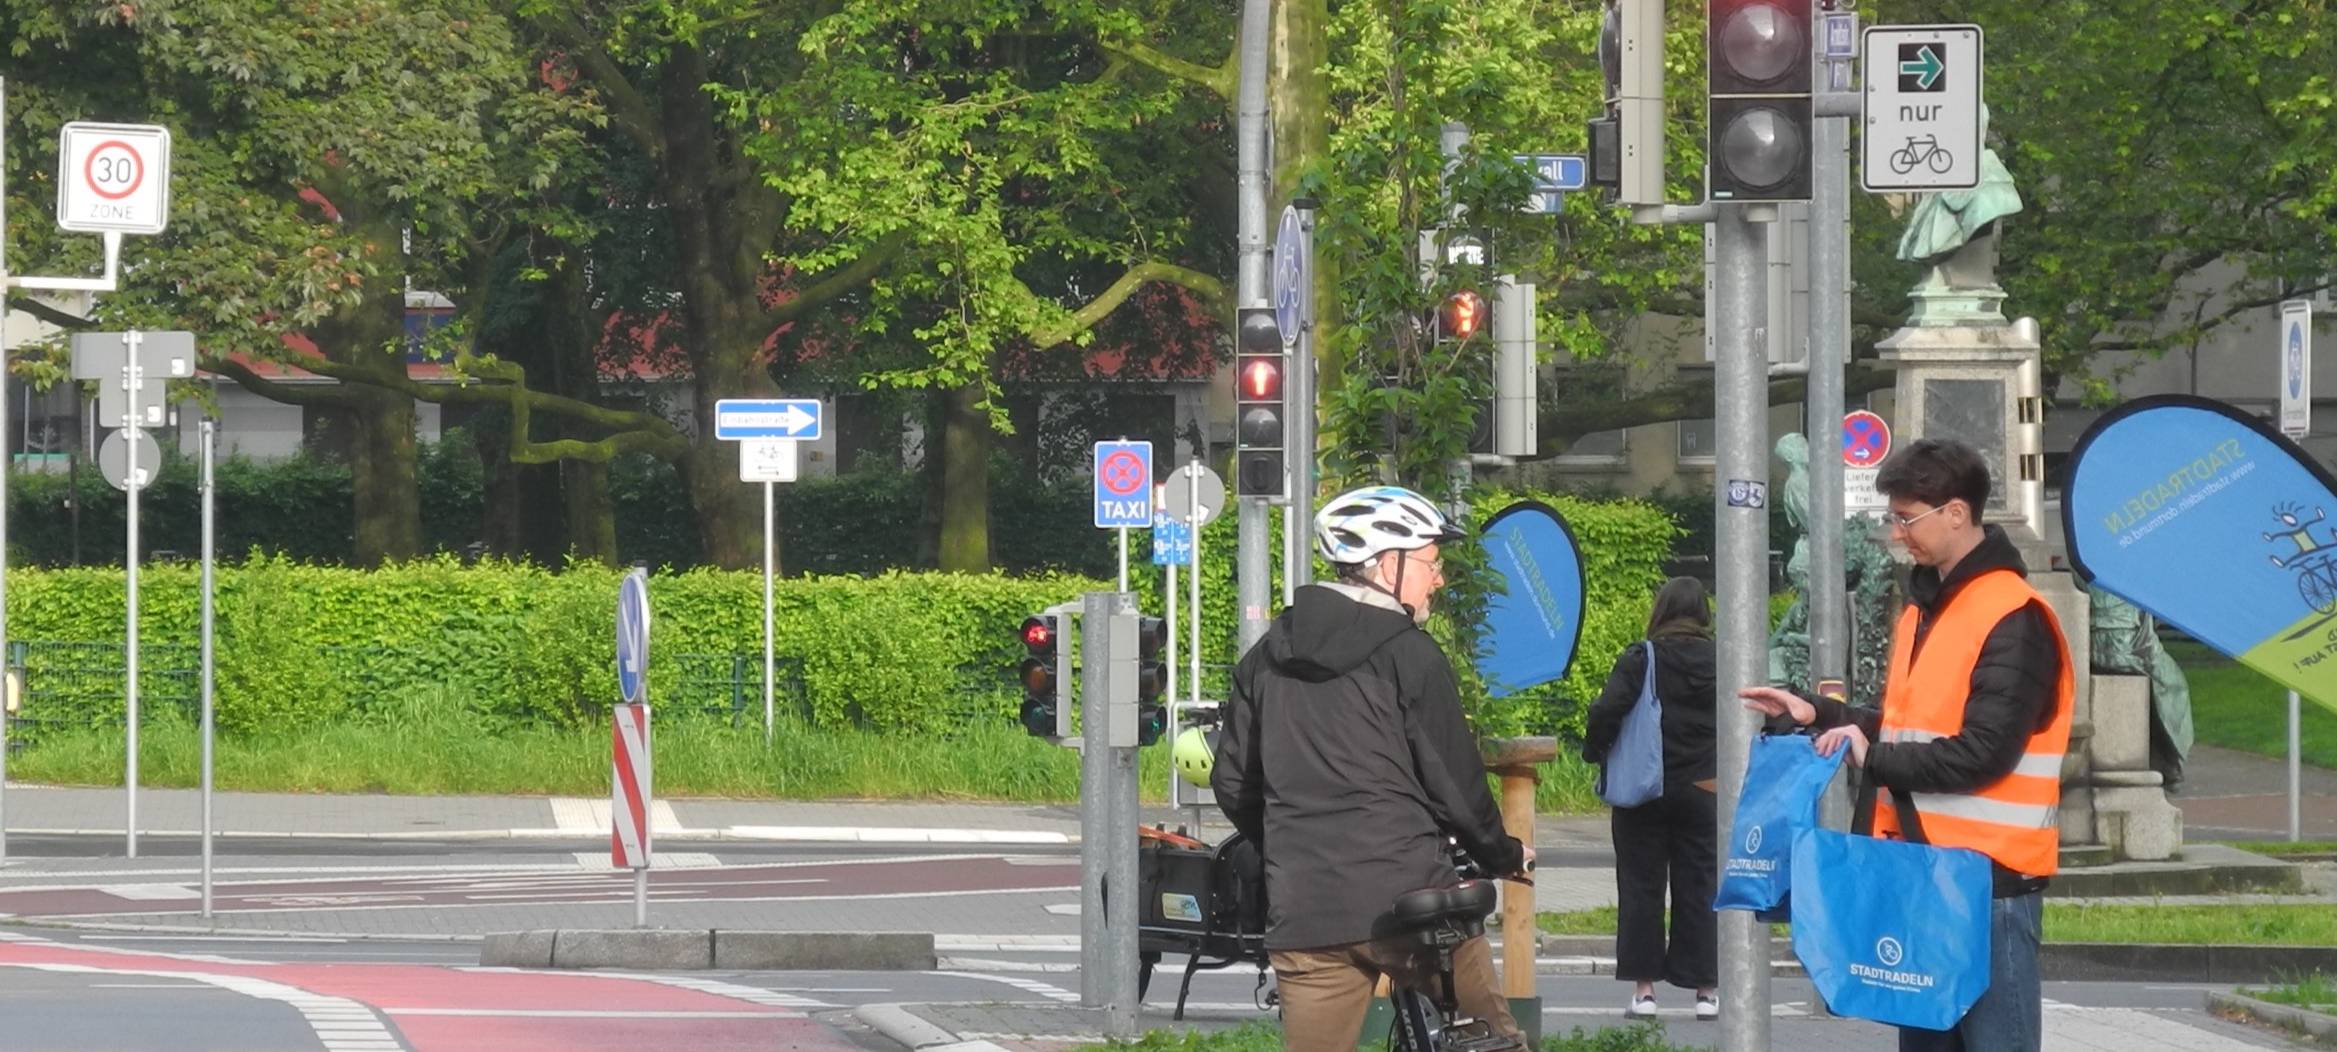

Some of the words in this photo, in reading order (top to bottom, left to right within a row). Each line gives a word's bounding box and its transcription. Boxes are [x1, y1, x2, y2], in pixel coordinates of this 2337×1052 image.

[1899, 104, 1943, 122] nur
[97, 156, 132, 184] 30
[89, 203, 135, 220] ZONE
[1101, 501, 1146, 519] TAXI
[1850, 963, 1934, 987] STADTRADELN
